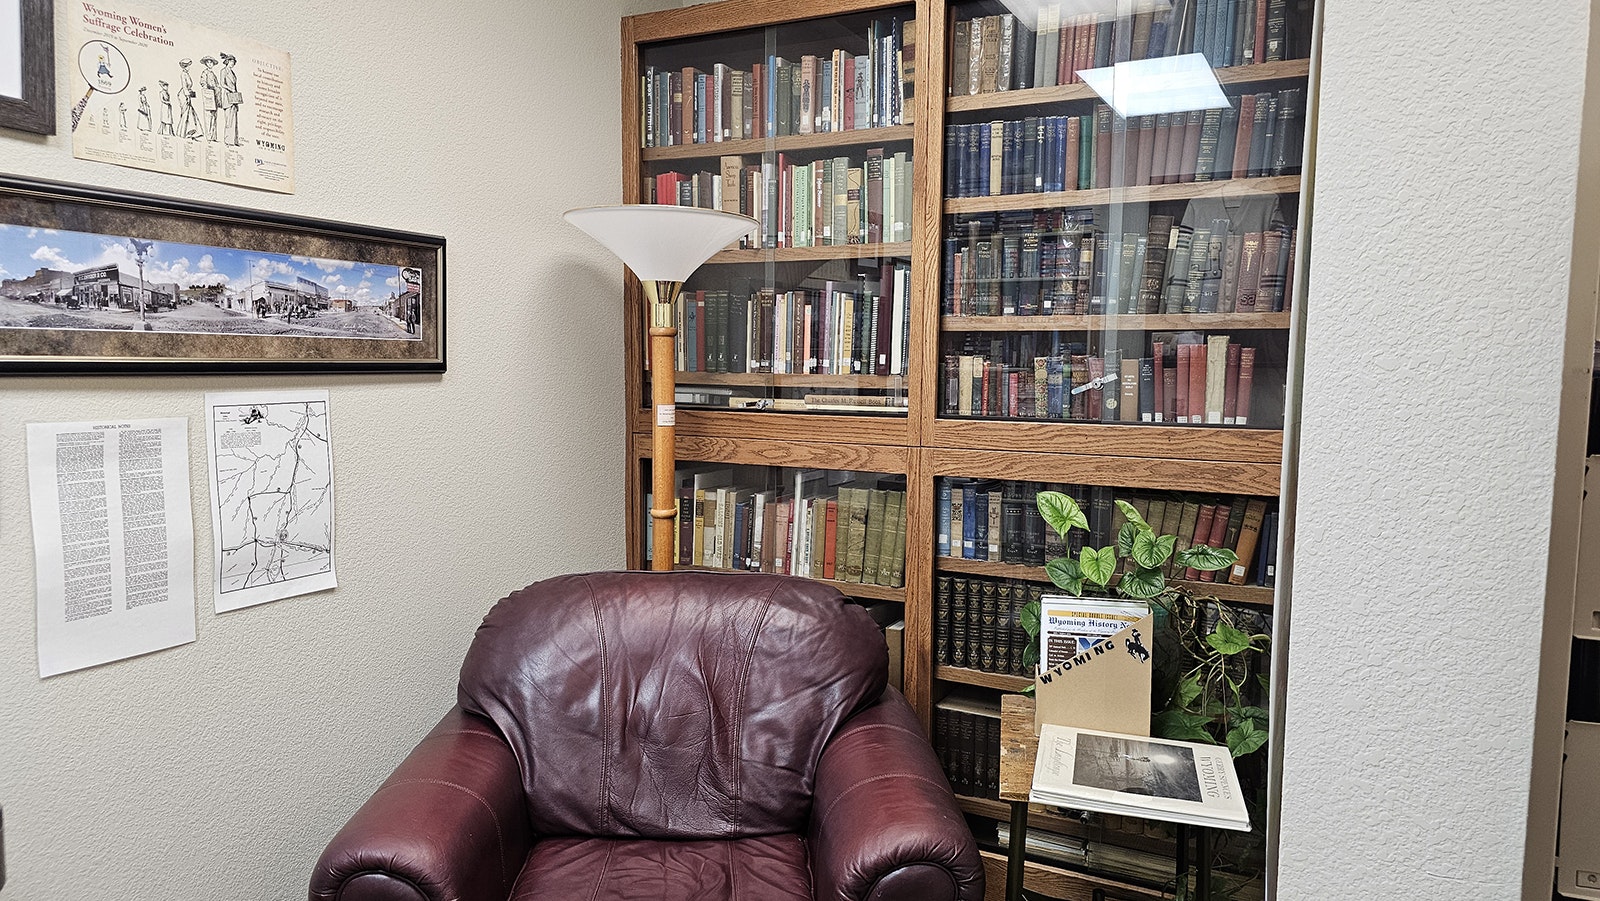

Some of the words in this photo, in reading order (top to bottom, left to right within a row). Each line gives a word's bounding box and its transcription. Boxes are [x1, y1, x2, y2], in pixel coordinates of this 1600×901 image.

[82, 2, 128, 24] Wyoming
[129, 16, 167, 34] Women's
[82, 14, 121, 33] Suffrage
[124, 25, 174, 47] Celebration
[256, 139, 286, 151] WYOMING
[1049, 616, 1086, 627] Wyoming
[1088, 619, 1118, 629] History
[1040, 640, 1115, 684] WYOMING
[1200, 756, 1220, 798] WYOMING
